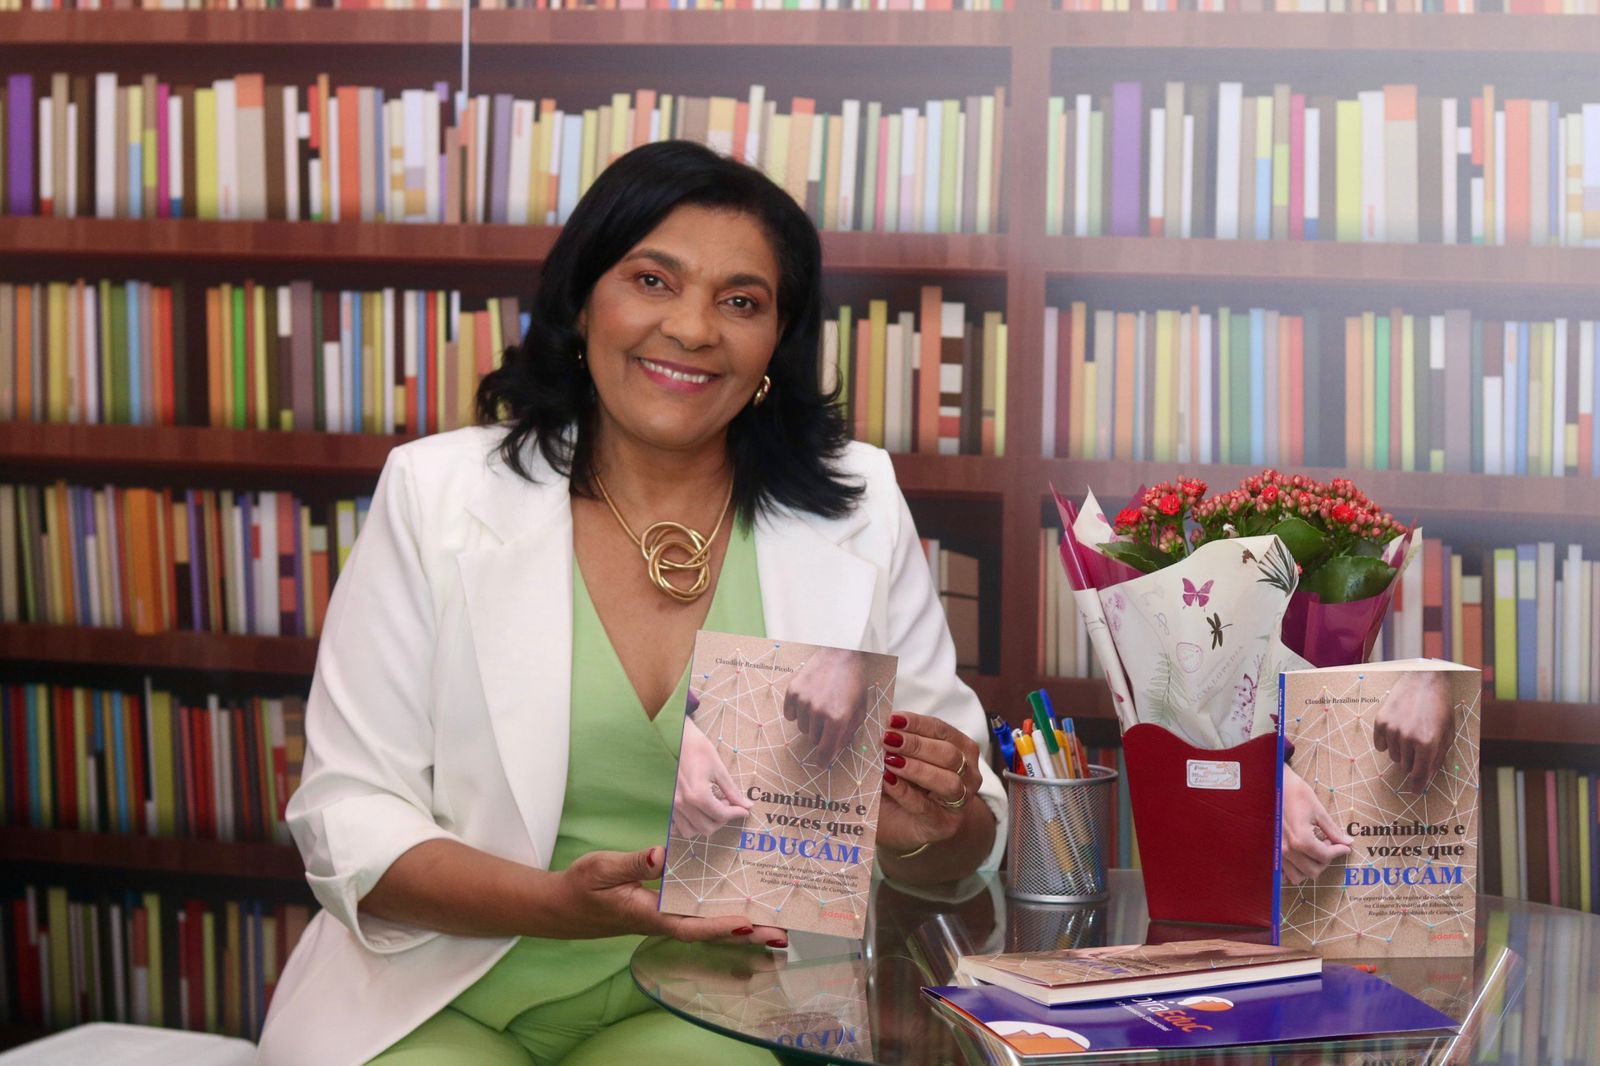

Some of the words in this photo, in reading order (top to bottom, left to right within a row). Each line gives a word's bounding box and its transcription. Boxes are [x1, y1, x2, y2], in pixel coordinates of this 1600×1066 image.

[774, 665, 794, 673] Picolo
[1360, 696, 1380, 704] Picolo
[747, 786, 850, 814] Caminhos
[855, 804, 867, 816] e
[765, 813, 822, 831] vozes
[826, 821, 865, 837] que
[1346, 820, 1449, 837] Caminhos
[1454, 823, 1465, 836] e
[739, 831, 861, 865] EDUCAM
[1367, 845, 1422, 857] vozes
[1427, 845, 1465, 860] que
[1344, 865, 1463, 887] EDUCAM
